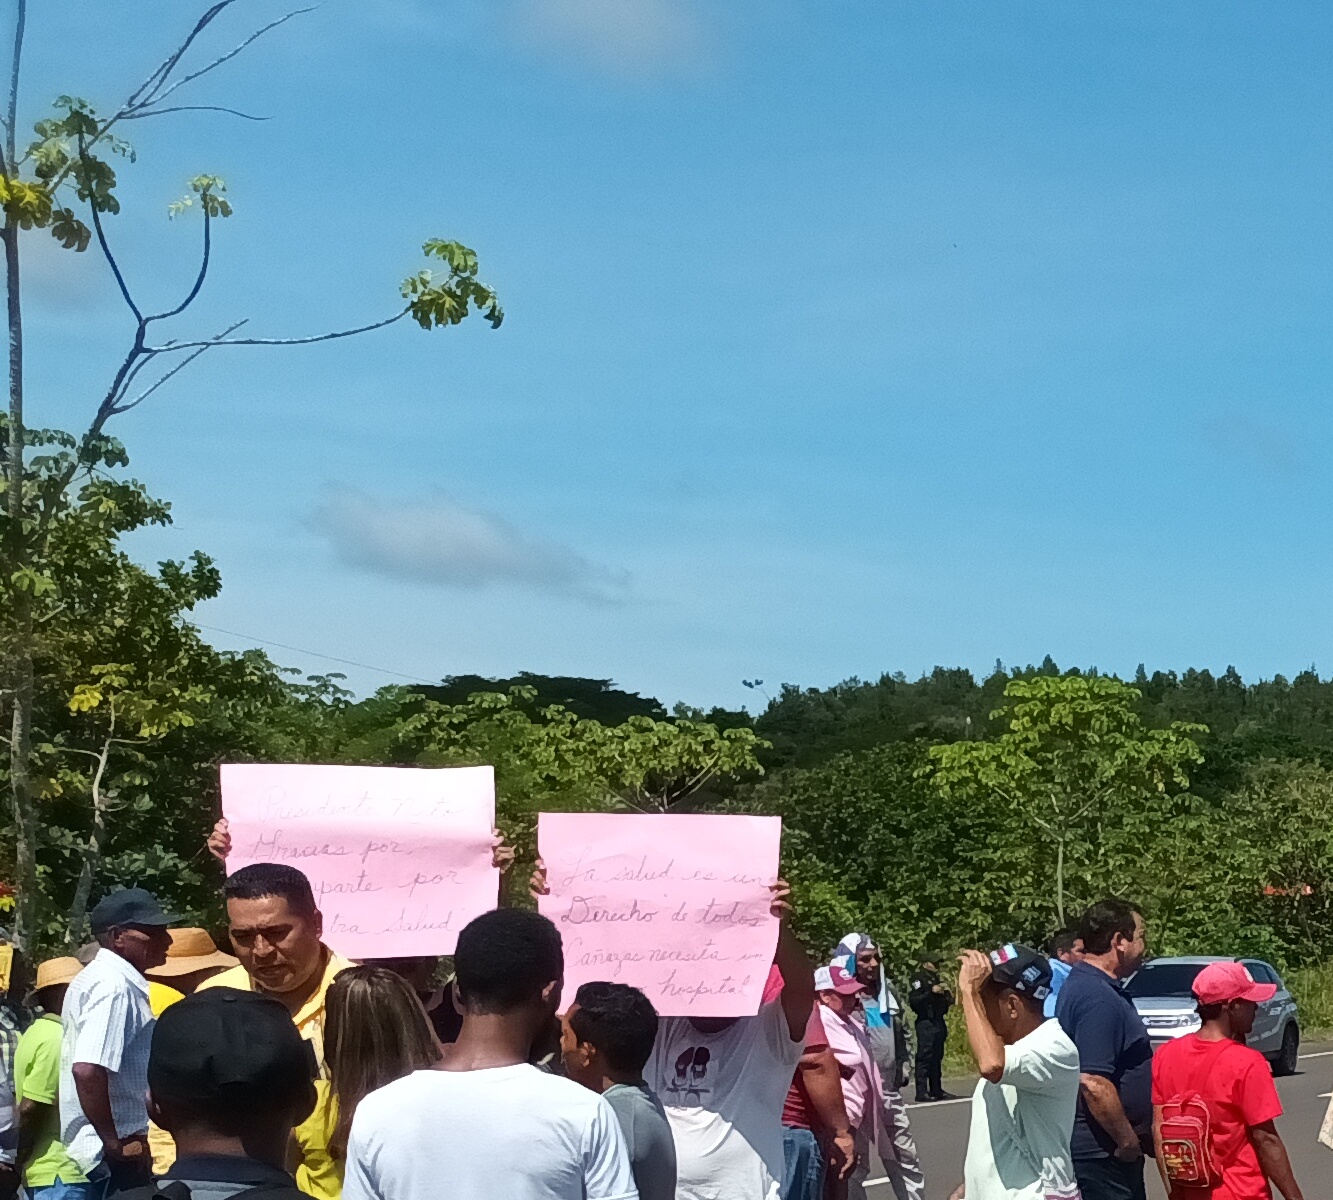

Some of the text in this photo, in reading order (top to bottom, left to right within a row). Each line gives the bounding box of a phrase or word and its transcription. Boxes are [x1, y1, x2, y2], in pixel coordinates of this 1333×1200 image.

[562, 846, 601, 887] La
[399, 870, 464, 897] por
[561, 895, 768, 926] Derecho de todos
